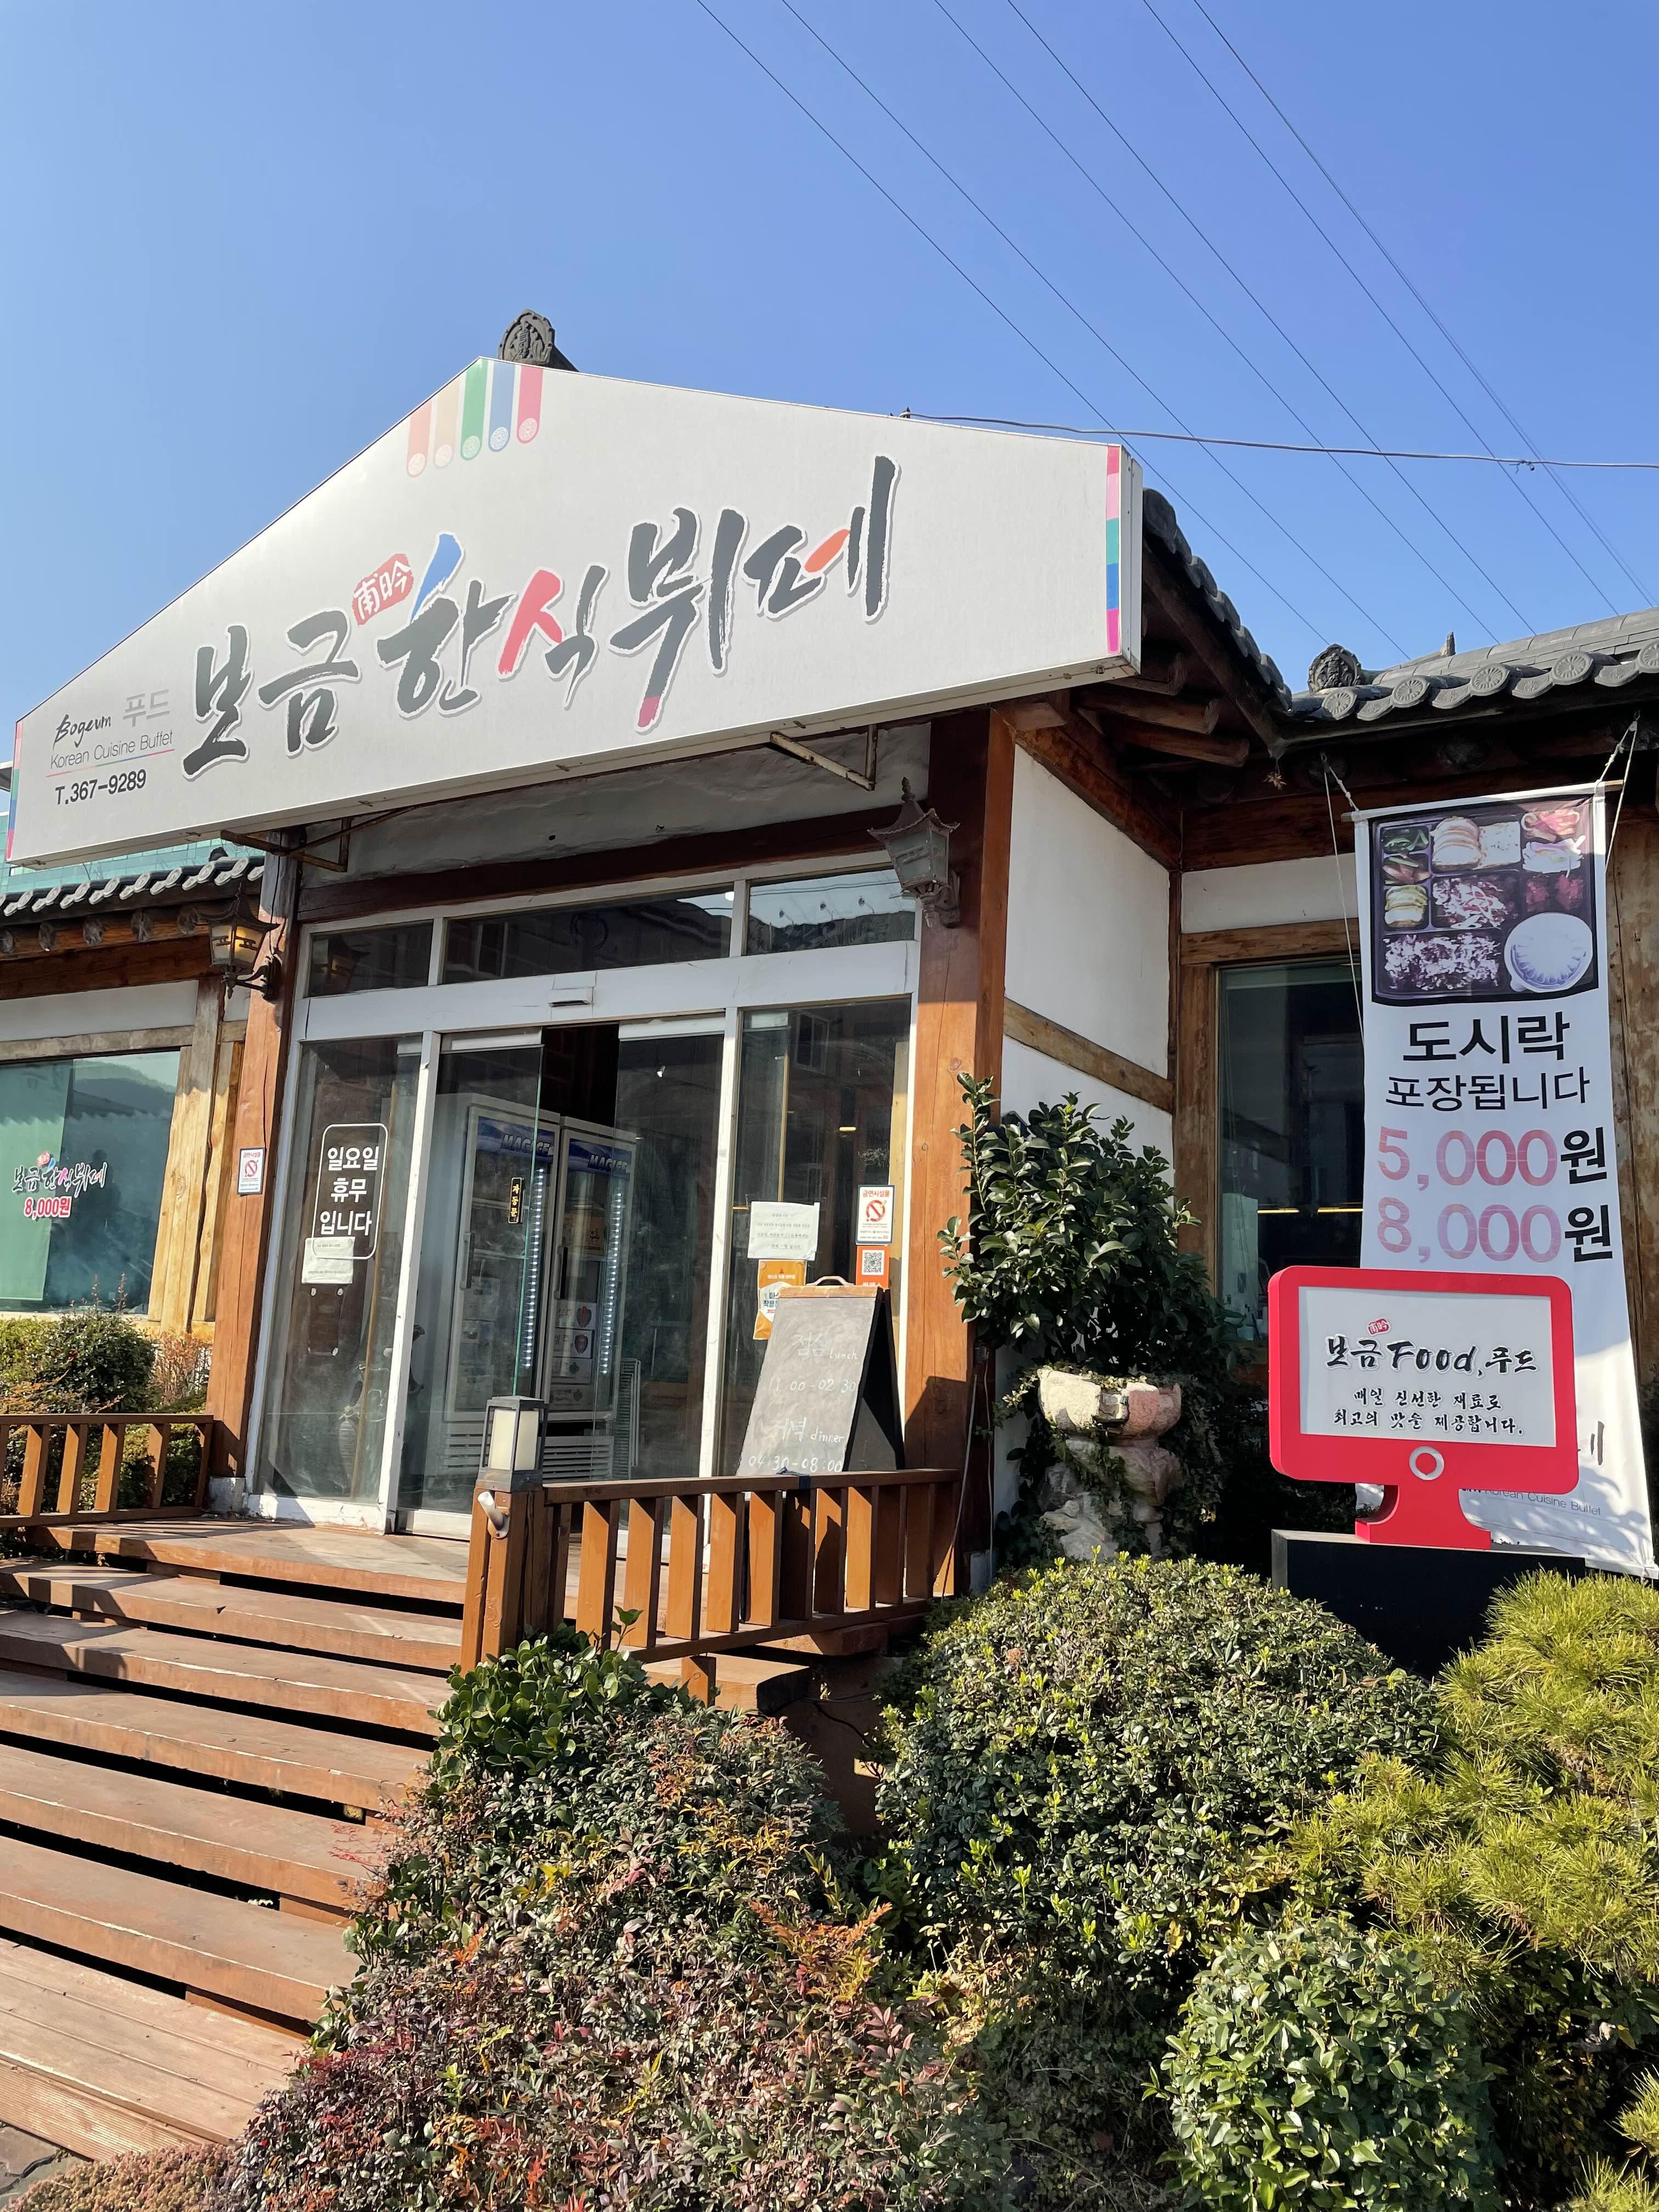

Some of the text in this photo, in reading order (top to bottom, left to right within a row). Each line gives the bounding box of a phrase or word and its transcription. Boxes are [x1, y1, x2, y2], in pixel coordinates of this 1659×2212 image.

[182, 609, 360, 776] 보금
[53, 689, 170, 751] Bogeum 푸드
[50, 730, 173, 769] Korean Cuisine Buffet
[55, 769, 146, 805] T.367-9289
[1403, 1012, 1570, 1063] 도시락
[1386, 1066, 1590, 1111] 포장됩니다
[328, 1146, 379, 1170] 일요일
[1378, 1126, 1607, 1191] 5,000원
[12, 1165, 41, 1193] 보금
[330, 1177, 367, 1203] 휴무
[24, 1196, 72, 1220] 8,000원
[510, 1184, 520, 1217] 자동문
[320, 1210, 372, 1236] 입니다
[1377, 1197, 1613, 1263] 8,000원
[830, 1351, 858, 1361] Lunch
[1327, 1335, 1382, 1368] 보금
[1485, 1347, 1537, 1373] 푸드
[1354, 1388, 1501, 1410] 매일 신선한 재료로
[811, 1426, 845, 1443] dinner
[1334, 1409, 1522, 1434] 최고의 맛을 제공합니다.
[1527, 1492, 1566, 1508] Cuisine
